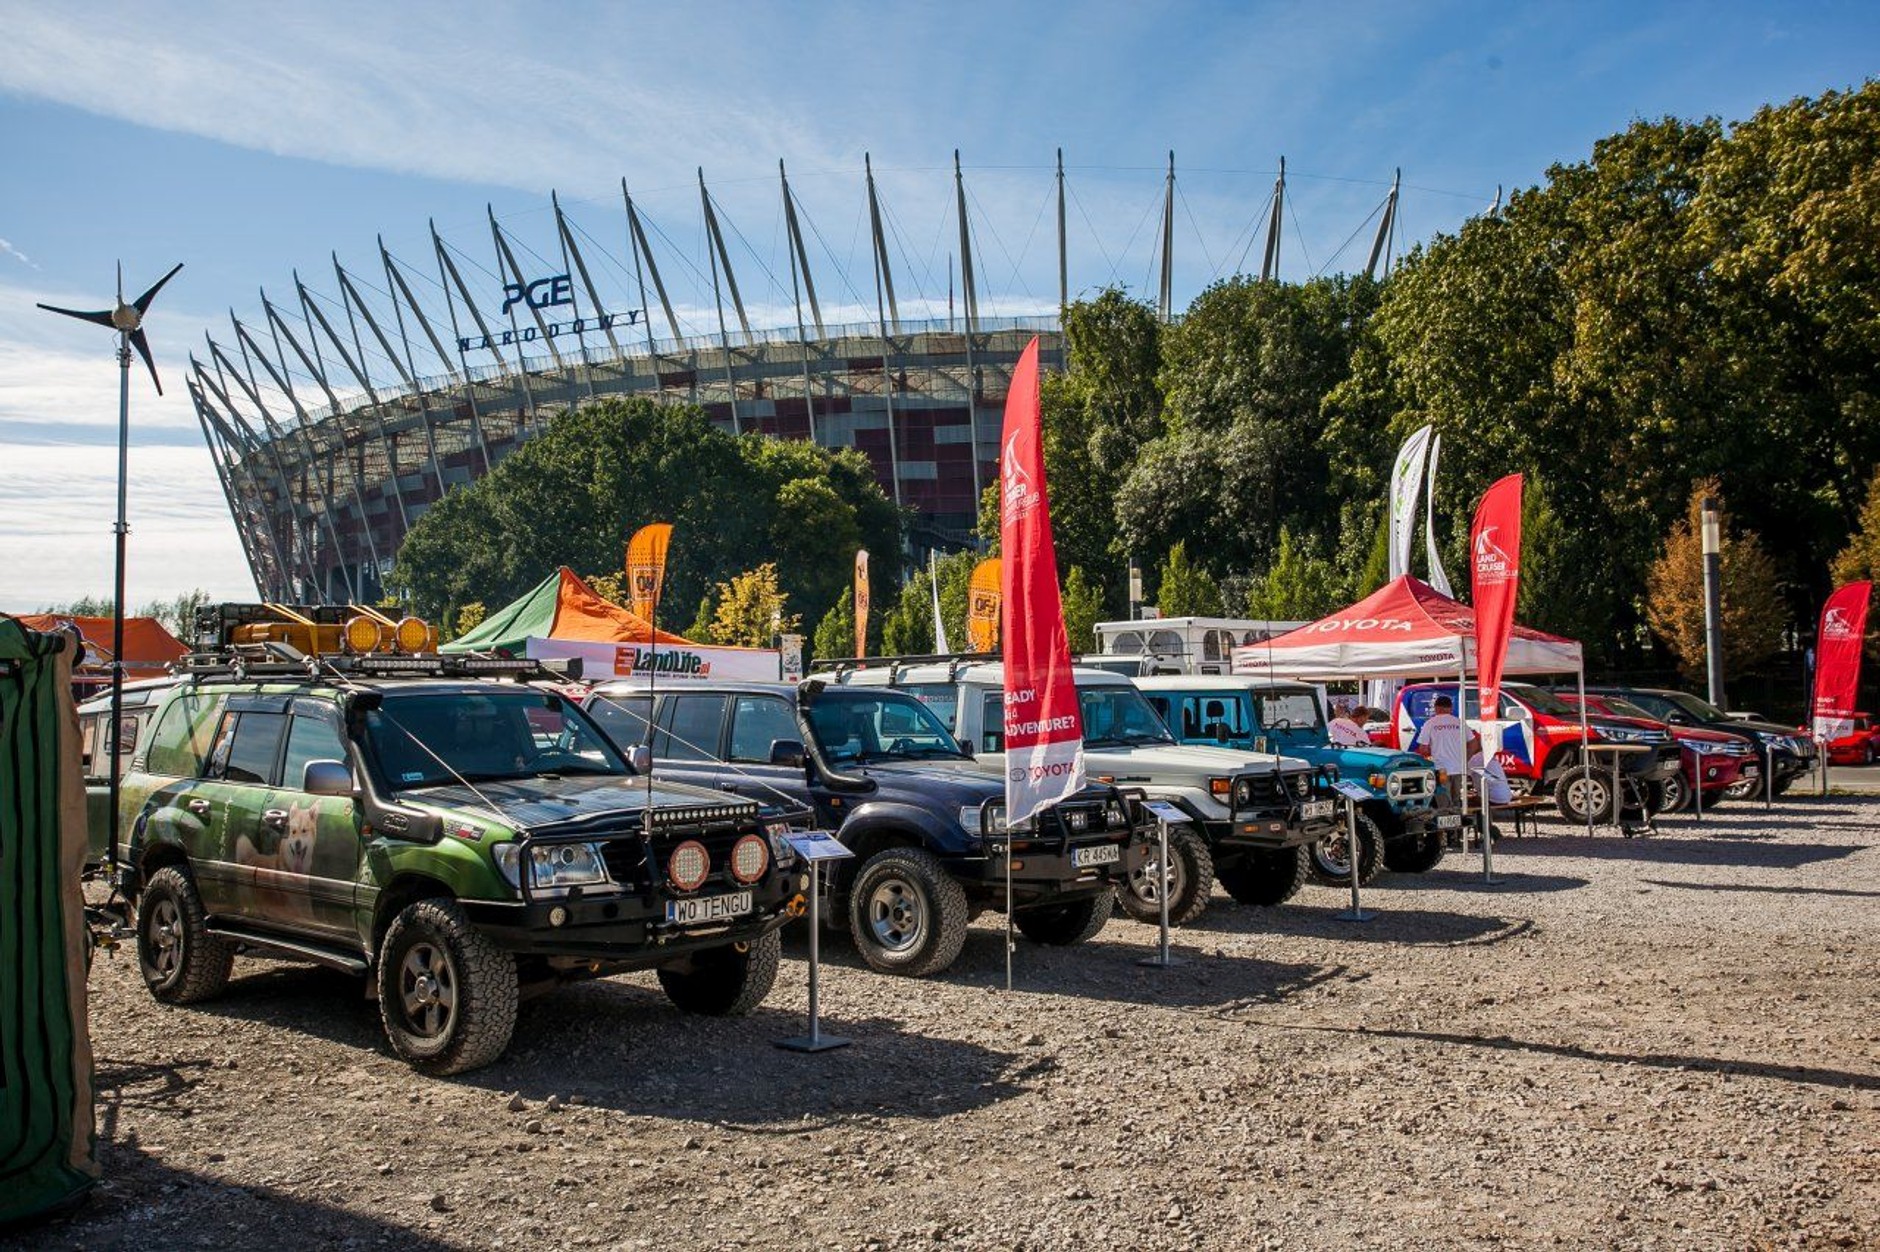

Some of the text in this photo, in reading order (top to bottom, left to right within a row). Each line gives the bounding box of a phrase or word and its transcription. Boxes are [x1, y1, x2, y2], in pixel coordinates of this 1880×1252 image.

[502, 274, 571, 315] PGE
[457, 310, 638, 352] NARODOWY
[1304, 618, 1413, 634] TOYOTA
[1418, 652, 1456, 662] TOYOTA
[1029, 762, 1075, 778] TOYOTA
[702, 893, 749, 919] TENGU
